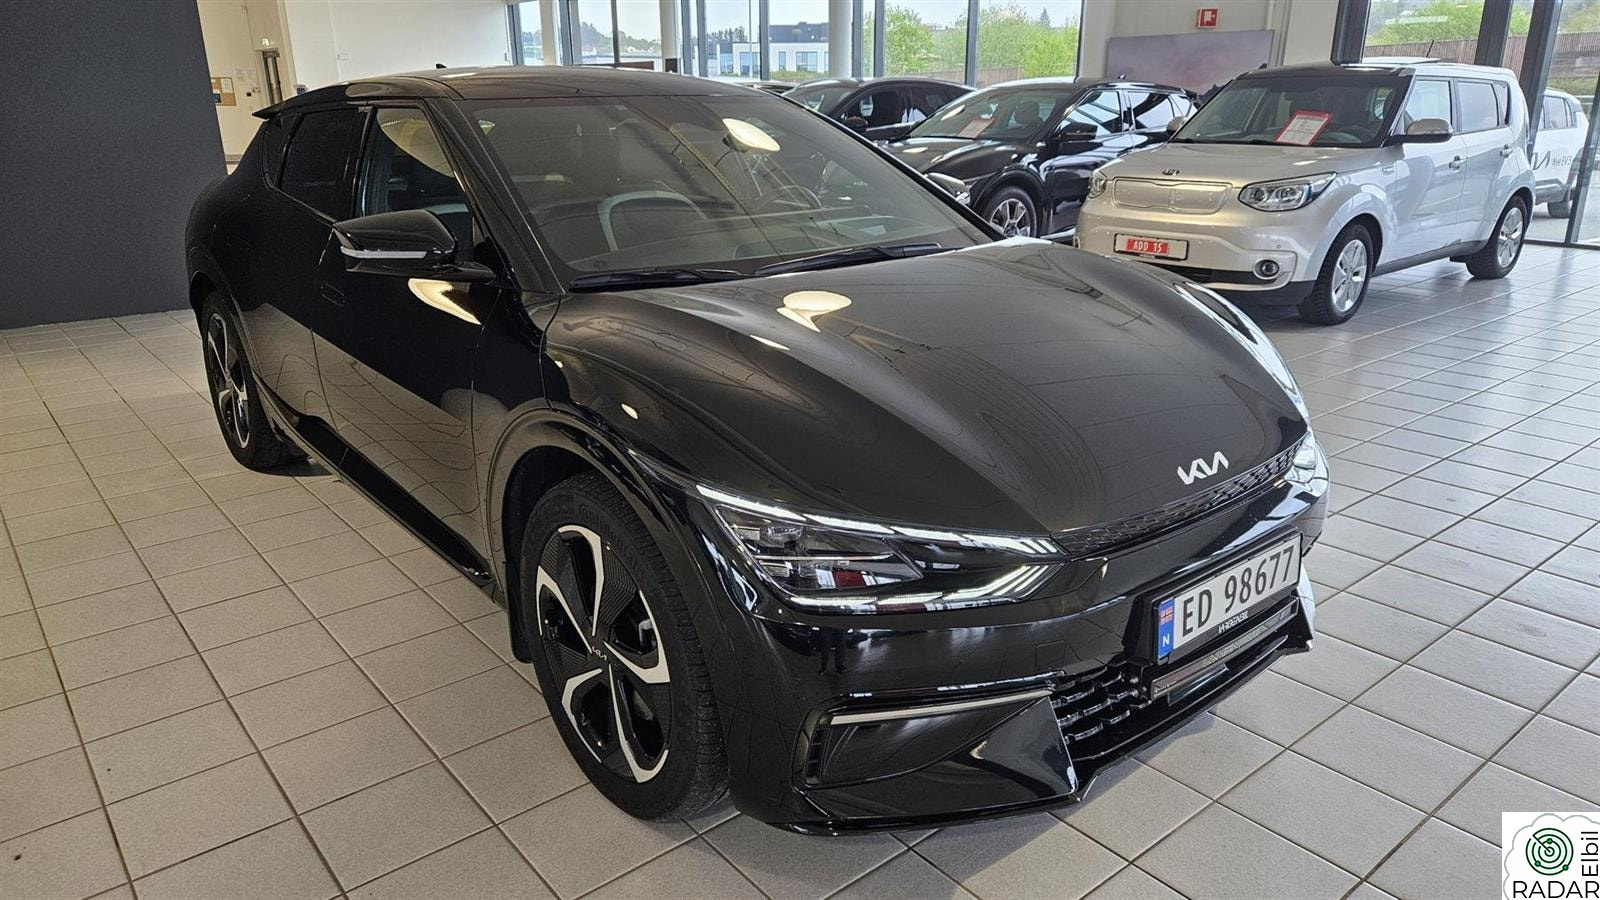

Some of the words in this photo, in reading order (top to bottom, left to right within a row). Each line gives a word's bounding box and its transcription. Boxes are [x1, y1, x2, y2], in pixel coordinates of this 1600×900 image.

[1133, 240, 1149, 251] ADD
[1153, 243, 1162, 253] 15
[1177, 451, 1229, 485] KIA
[1182, 588, 1213, 637] ED
[1224, 545, 1294, 614] 98677
[1162, 633, 1170, 648] N
